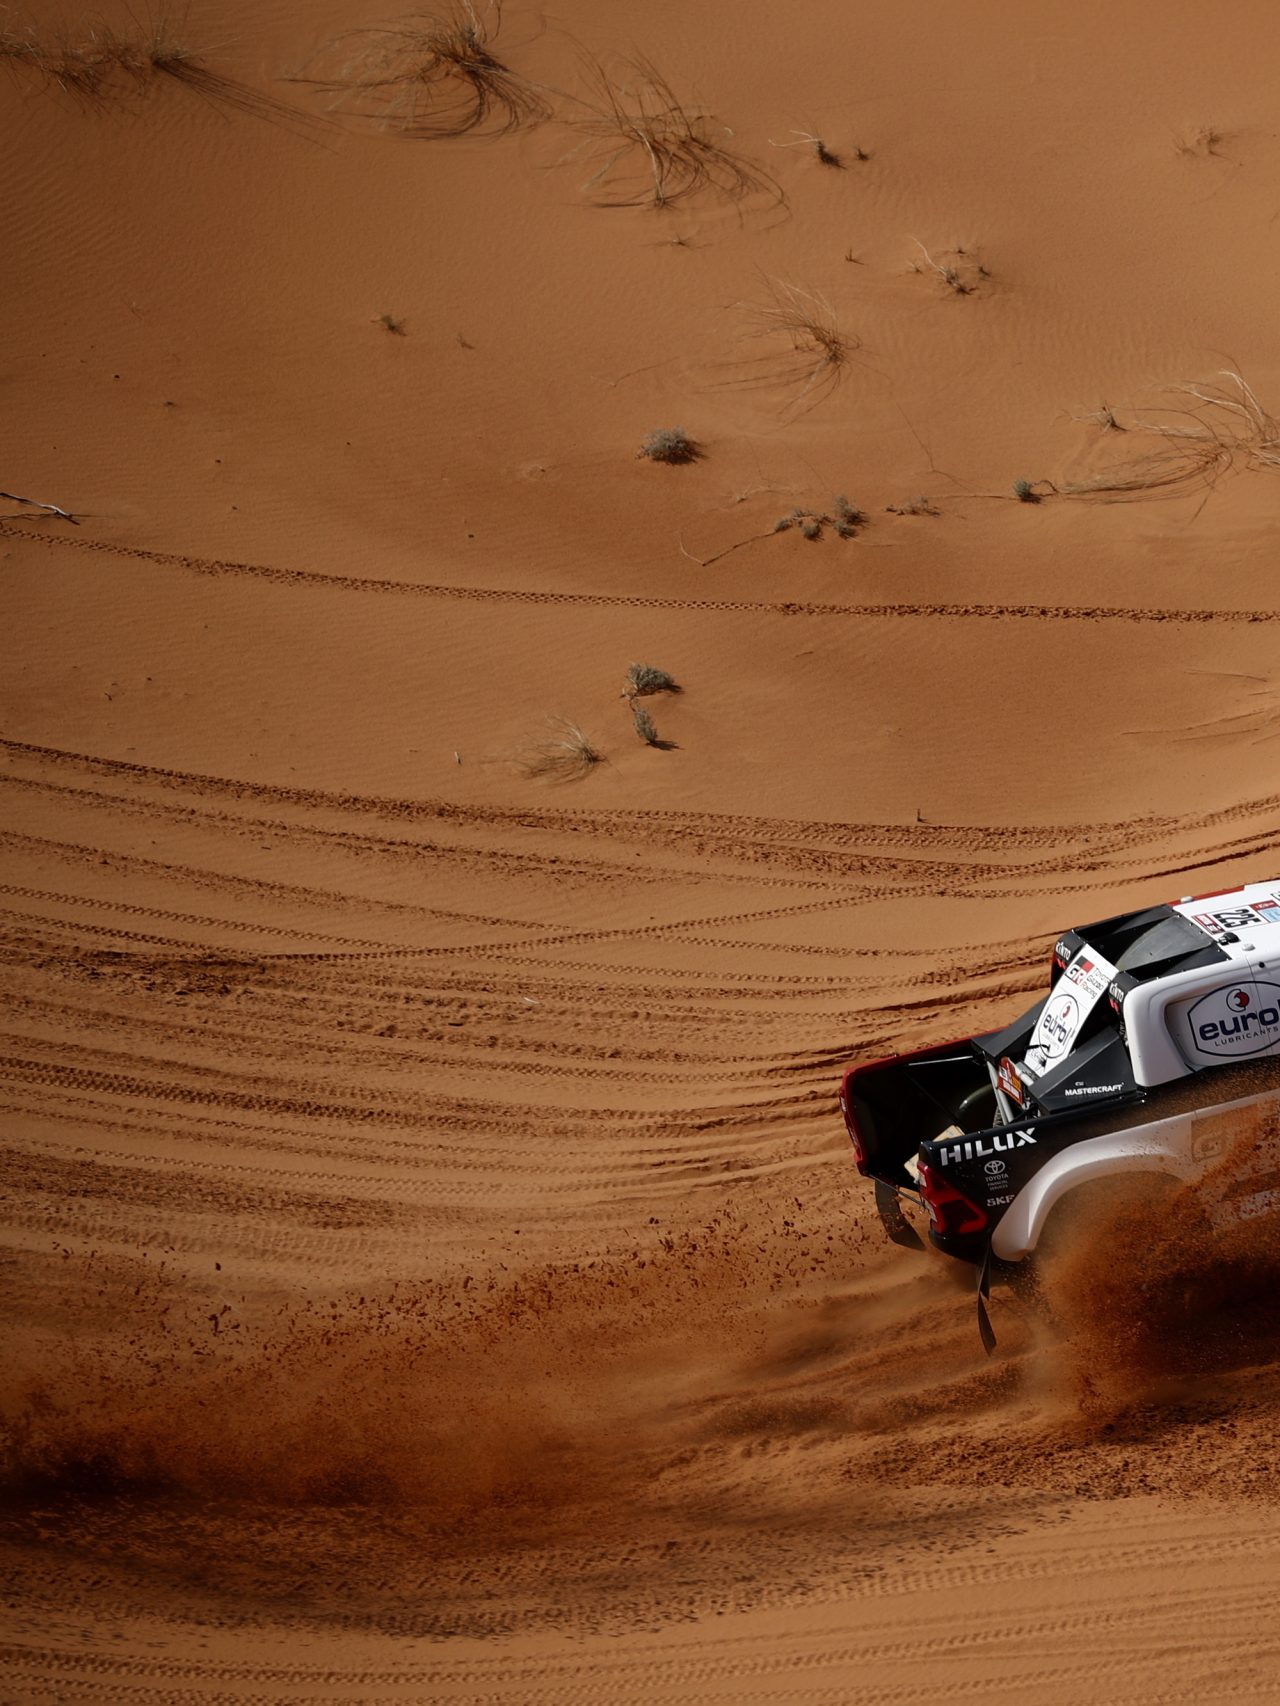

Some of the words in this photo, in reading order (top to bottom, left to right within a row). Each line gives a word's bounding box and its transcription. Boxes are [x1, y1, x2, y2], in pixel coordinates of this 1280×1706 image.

[1212, 908, 1262, 929] 225
[1214, 1025, 1279, 1047] LUBRICANTS
[1064, 1084, 1123, 1096] MASTERCRAFT
[940, 1127, 1038, 1167] HILUX
[984, 1173, 1009, 1183] TOYOTA
[986, 1195, 1015, 1207] SKF
